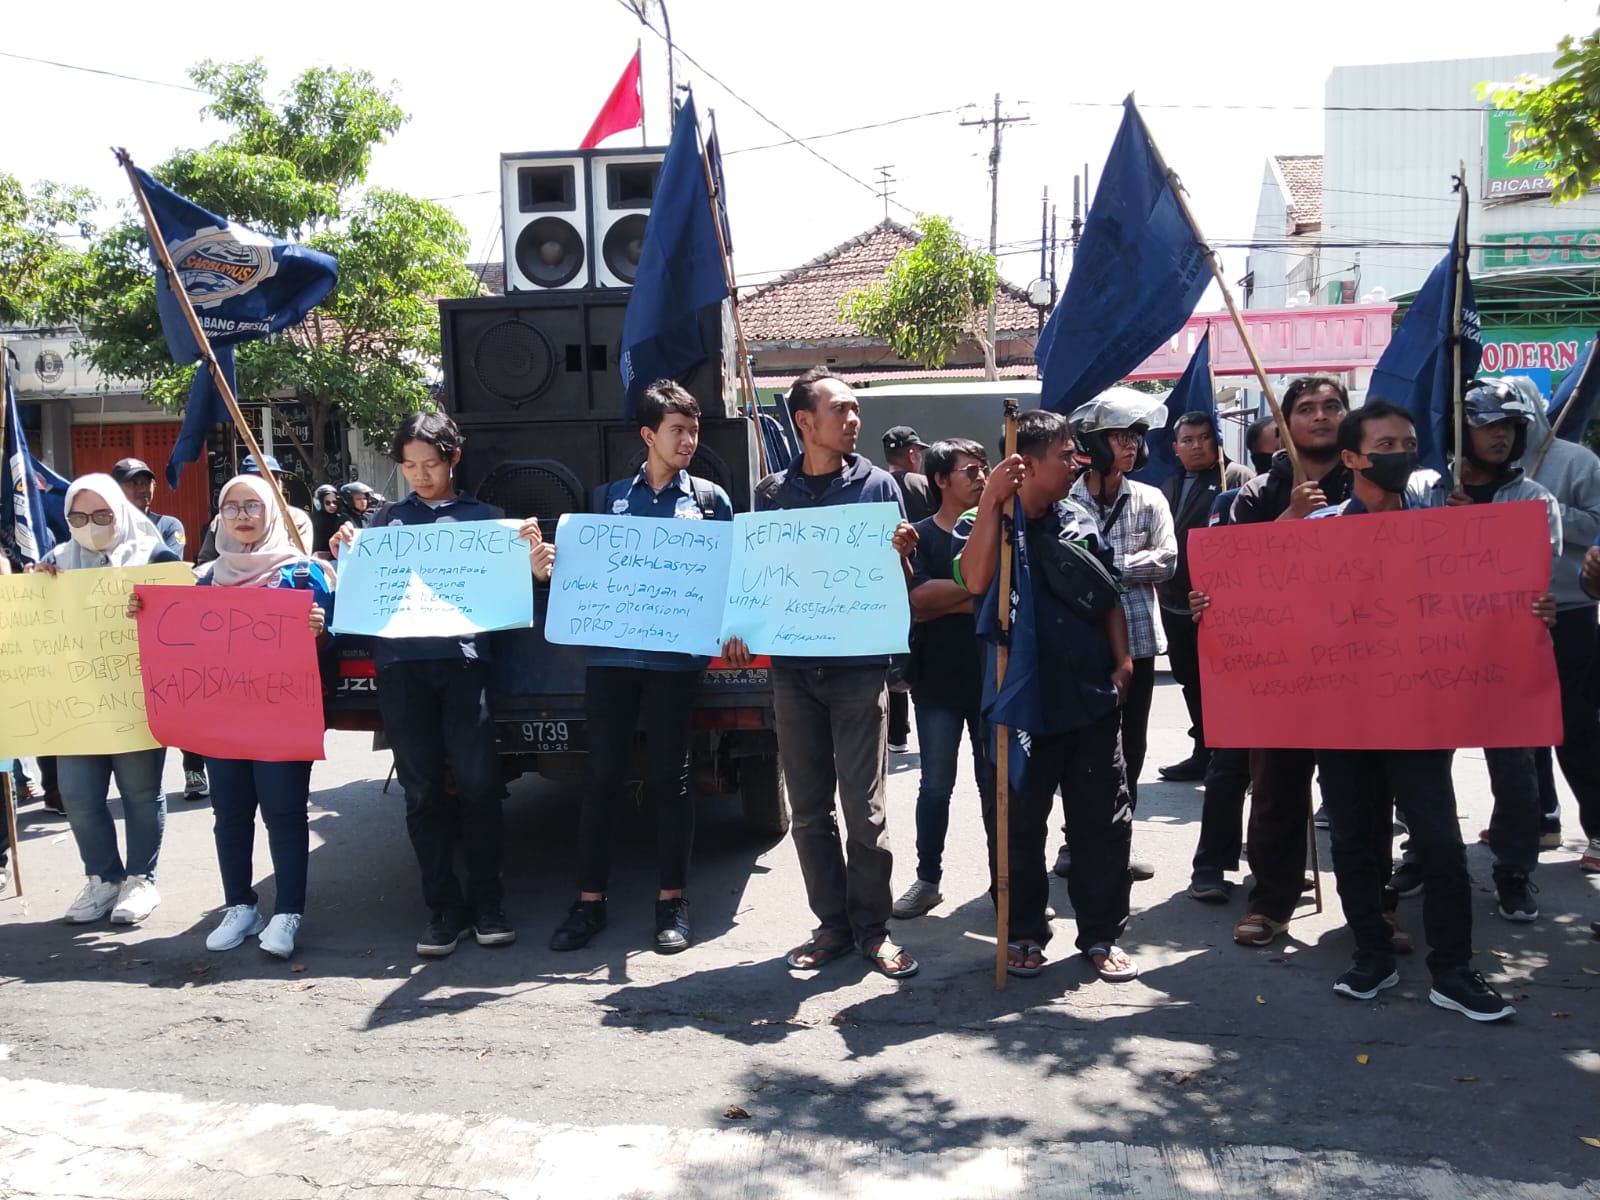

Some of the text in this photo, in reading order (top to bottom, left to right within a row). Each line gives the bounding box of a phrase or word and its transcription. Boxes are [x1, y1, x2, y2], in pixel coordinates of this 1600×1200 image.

[1504, 233, 1600, 263] FOTO
[181, 255, 257, 282] SARBUMUSI
[197, 316, 236, 331] ABANG
[1477, 341, 1577, 374] ODERN
[1372, 514, 1502, 547] AUDIT
[811, 565, 885, 590] 2026
[1200, 548, 1524, 594] DAN EVALUASI TOTAL
[0, 584, 46, 602] UKAN
[421, 580, 467, 592] erguna
[1330, 596, 1400, 628] LKS
[156, 601, 301, 655] COPOT
[570, 617, 614, 636] DPRD
[1311, 639, 1403, 666] DETEKSI
[67, 652, 142, 684] DEPE
[521, 721, 569, 742] 9739
